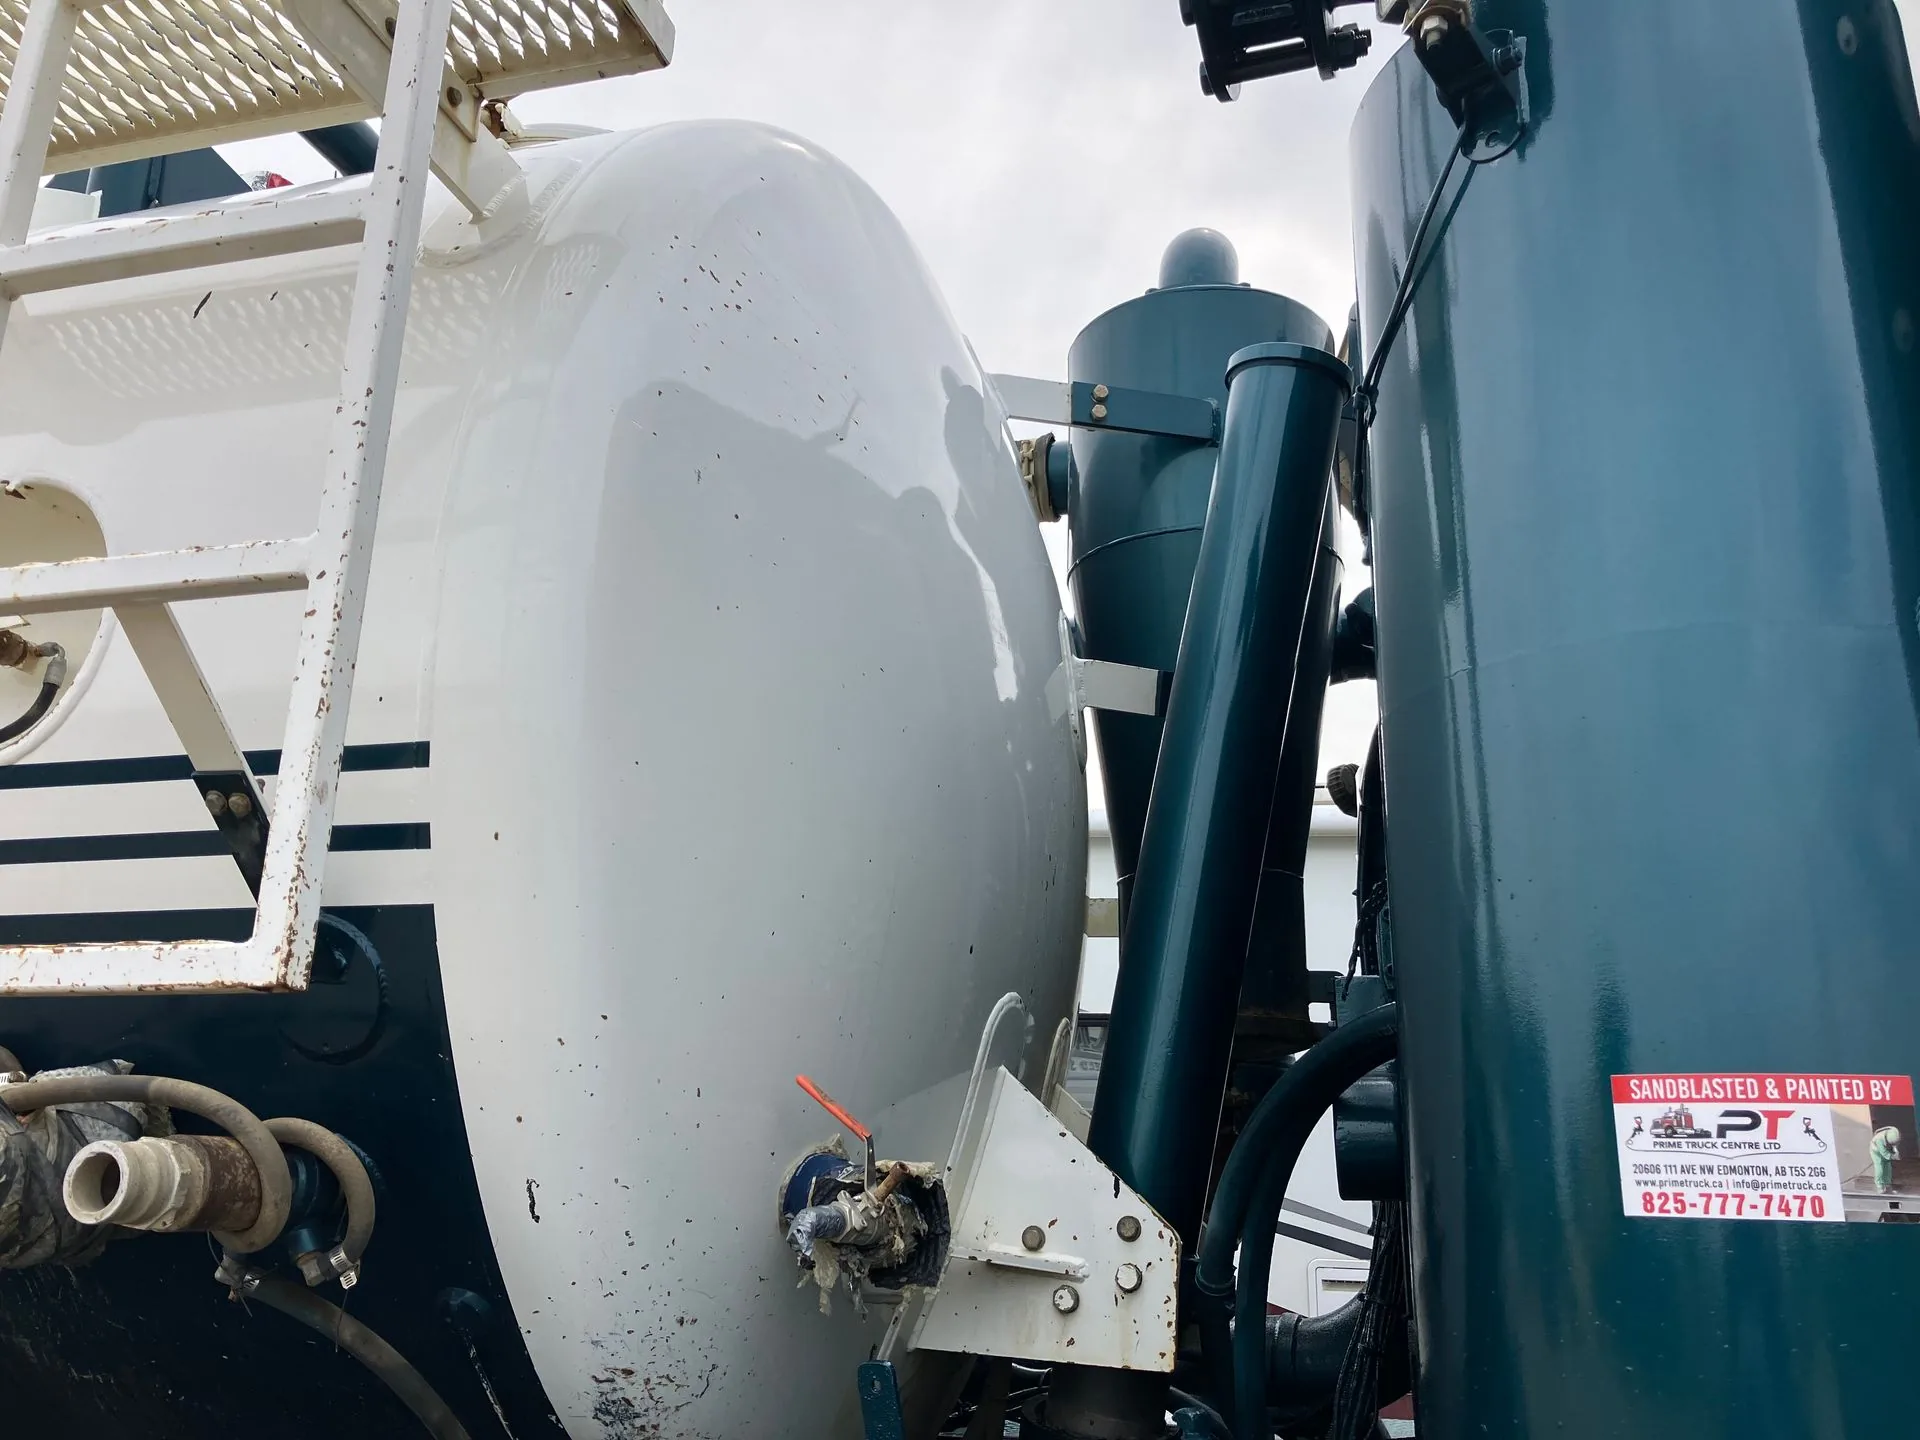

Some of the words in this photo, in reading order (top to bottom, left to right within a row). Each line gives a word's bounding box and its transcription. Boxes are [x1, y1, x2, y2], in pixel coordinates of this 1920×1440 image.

[1629, 1078, 1759, 1100] SANDBLASTED
[1766, 1078, 1779, 1099] &
[1786, 1078, 1864, 1100] PAINTED
[1871, 1079, 1892, 1101] BY
[1716, 1109, 1795, 1140] PT
[1653, 1140, 1682, 1150] PRIME
[1686, 1140, 1717, 1150] TRUCK
[1721, 1141, 1760, 1150] CENTRE
[1763, 1141, 1781, 1150] LTD
[1632, 1163, 1661, 1176] 20606
[1664, 1164, 1678, 1175] 111
[1680, 1164, 1696, 1176] AVE
[1699, 1164, 1715, 1176] NW
[1717, 1164, 1773, 1178] EDMONTON,
[1774, 1165, 1787, 1177] AB
[1788, 1165, 1805, 1178] T5S
[1807, 1166, 1826, 1178] 2G6
[1635, 1178, 1723, 1191] www.primetruck.ca
[1732, 1179, 1827, 1192] info@primetruck.ca
[1642, 1192, 1825, 1218] 825-777-7470
